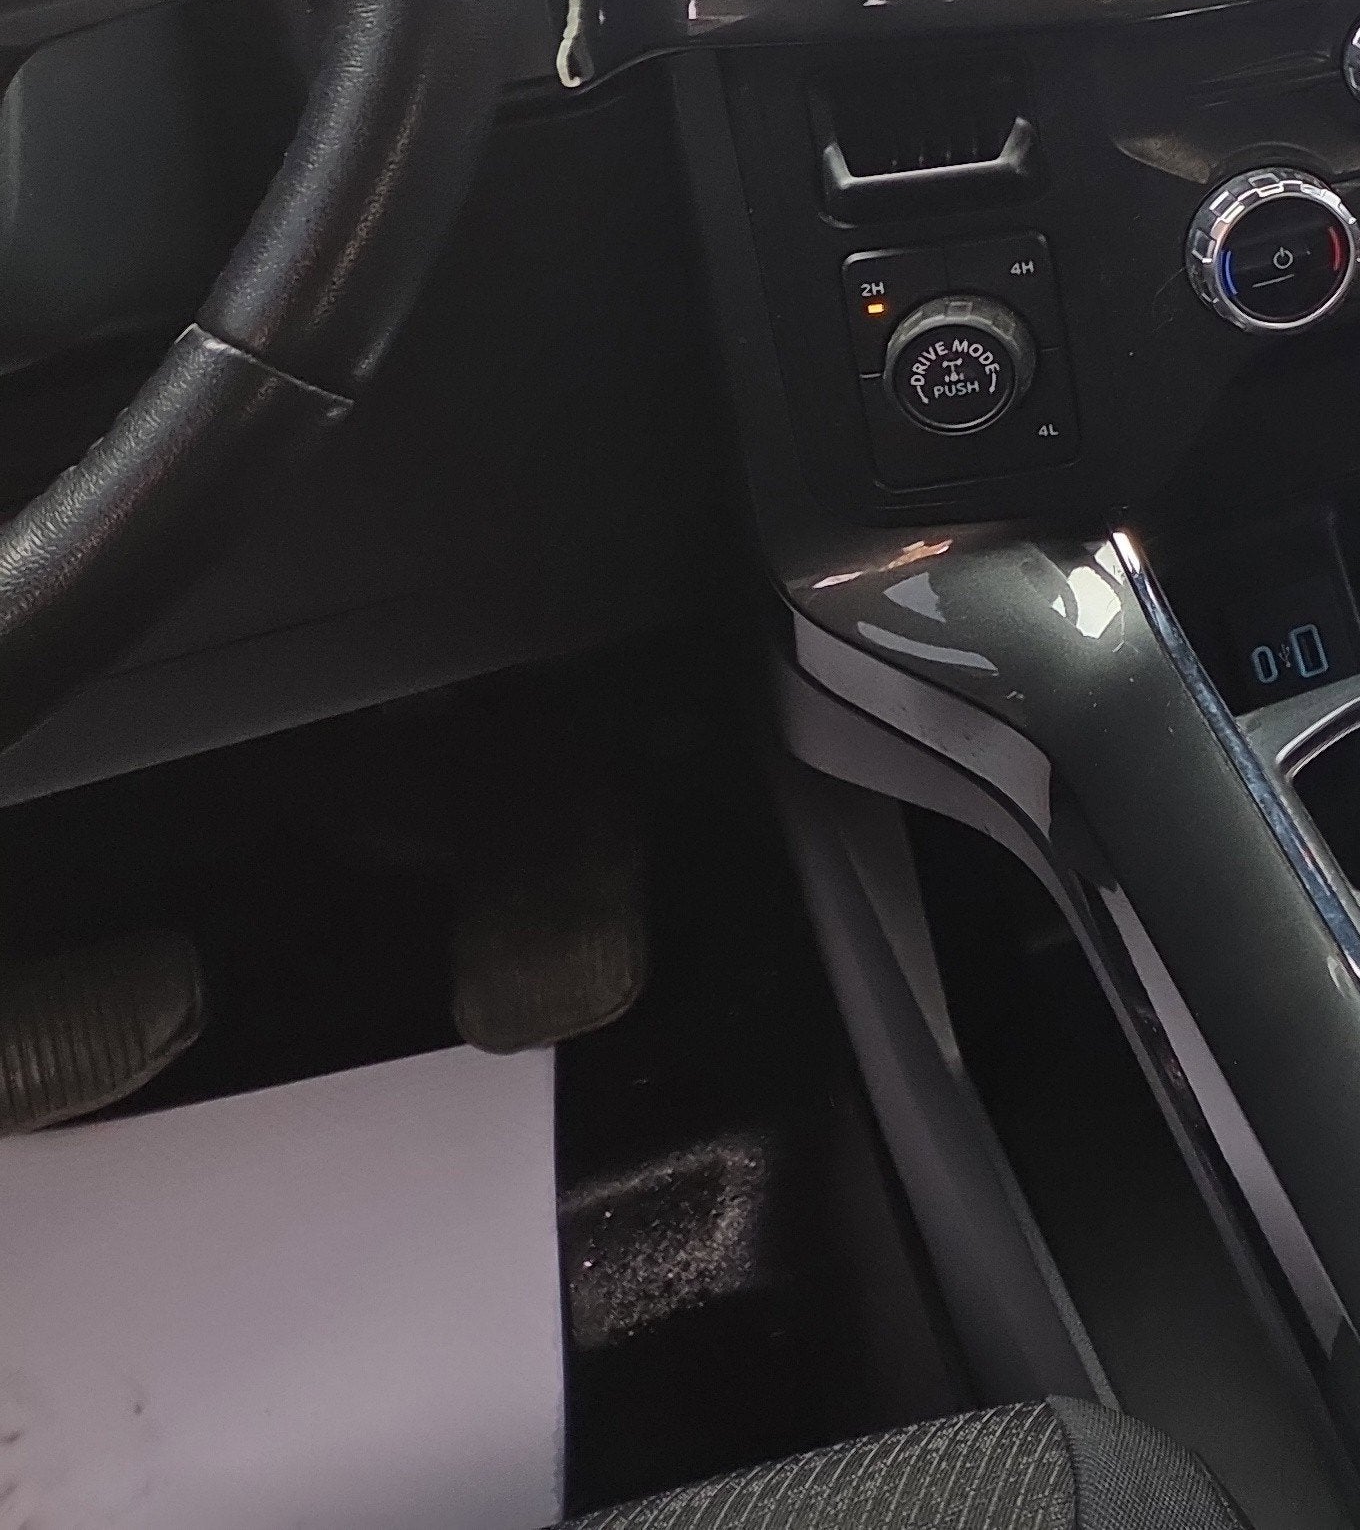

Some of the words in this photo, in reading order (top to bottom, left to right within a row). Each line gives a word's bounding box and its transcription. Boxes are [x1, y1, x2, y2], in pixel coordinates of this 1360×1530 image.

[1010, 260, 1035, 275] 4H
[860, 281, 885, 297] 2H
[910, 341, 949, 387] DRIVE
[952, 338, 1001, 375] MODE
[933, 380, 980, 399] PUSH
[1038, 424, 1059, 437] 4L
